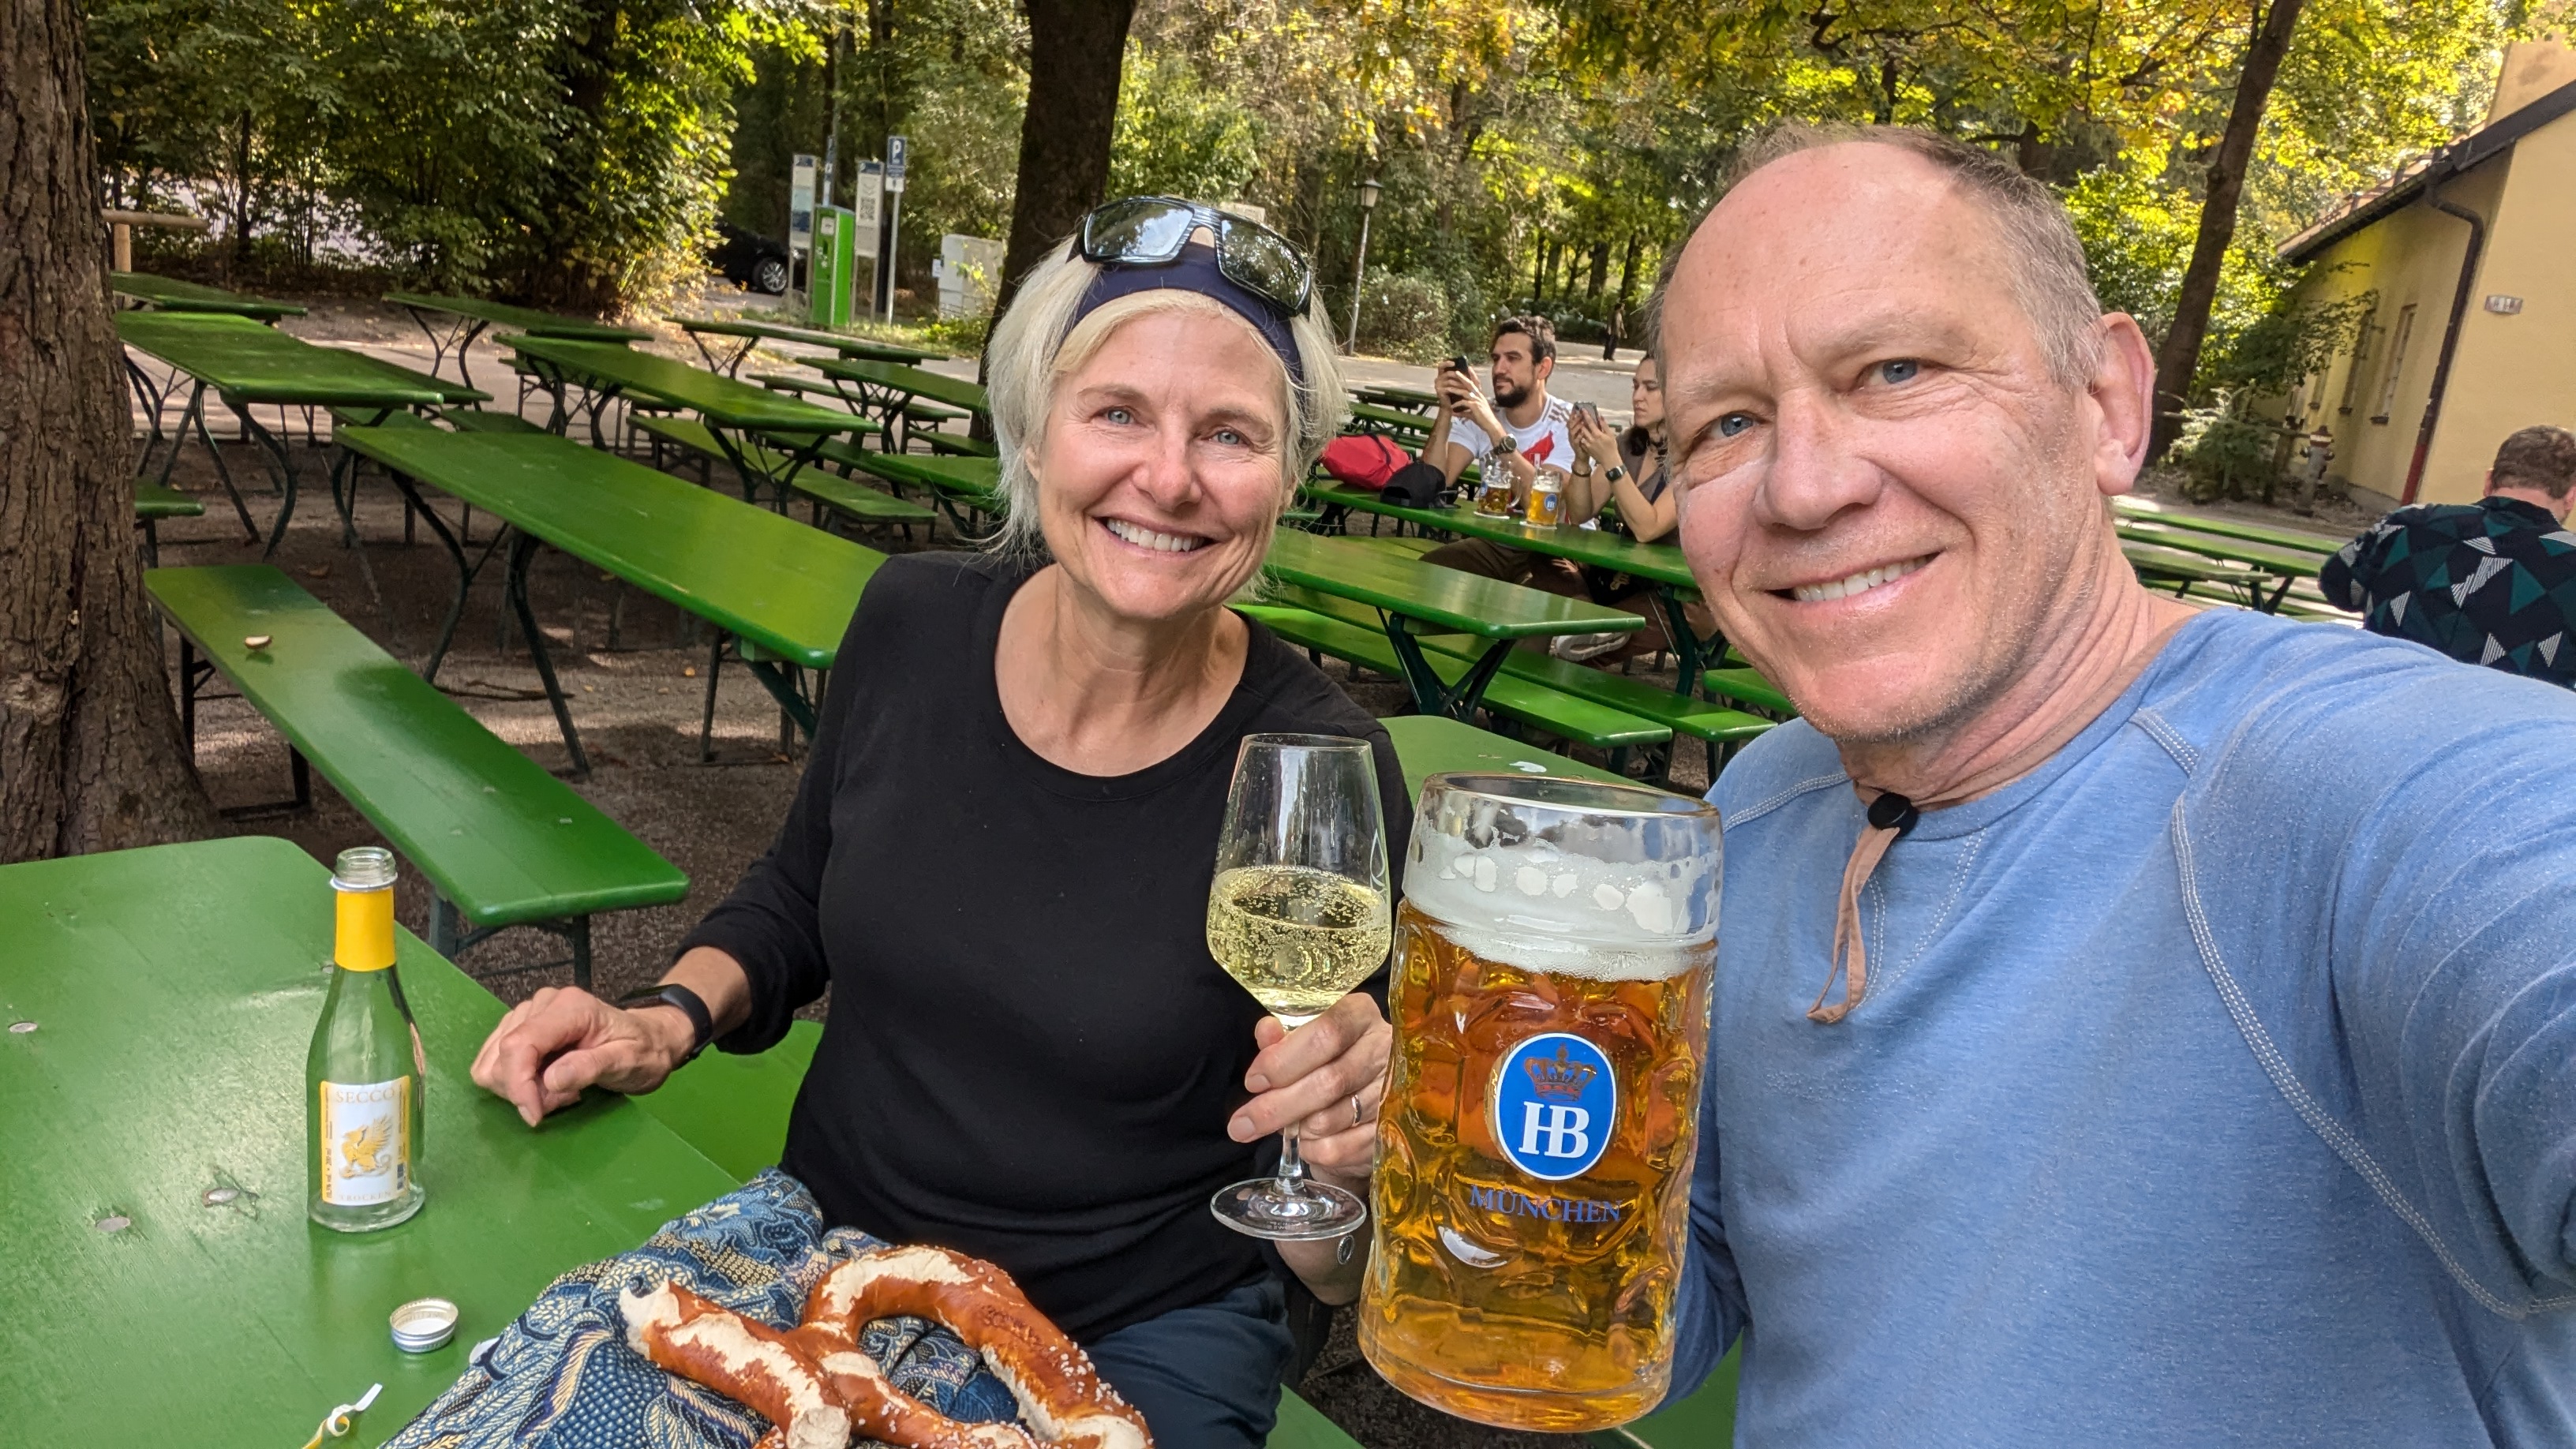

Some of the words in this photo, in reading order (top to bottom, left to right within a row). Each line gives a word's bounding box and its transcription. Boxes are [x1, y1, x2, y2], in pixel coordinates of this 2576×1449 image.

[893, 140, 902, 158] P
[335, 1088, 394, 1103] SECCO
[1518, 1101, 1589, 1159] HB
[339, 1191, 391, 1201] TROCKEN
[1470, 1185, 1623, 1223] MÜNCHEN
